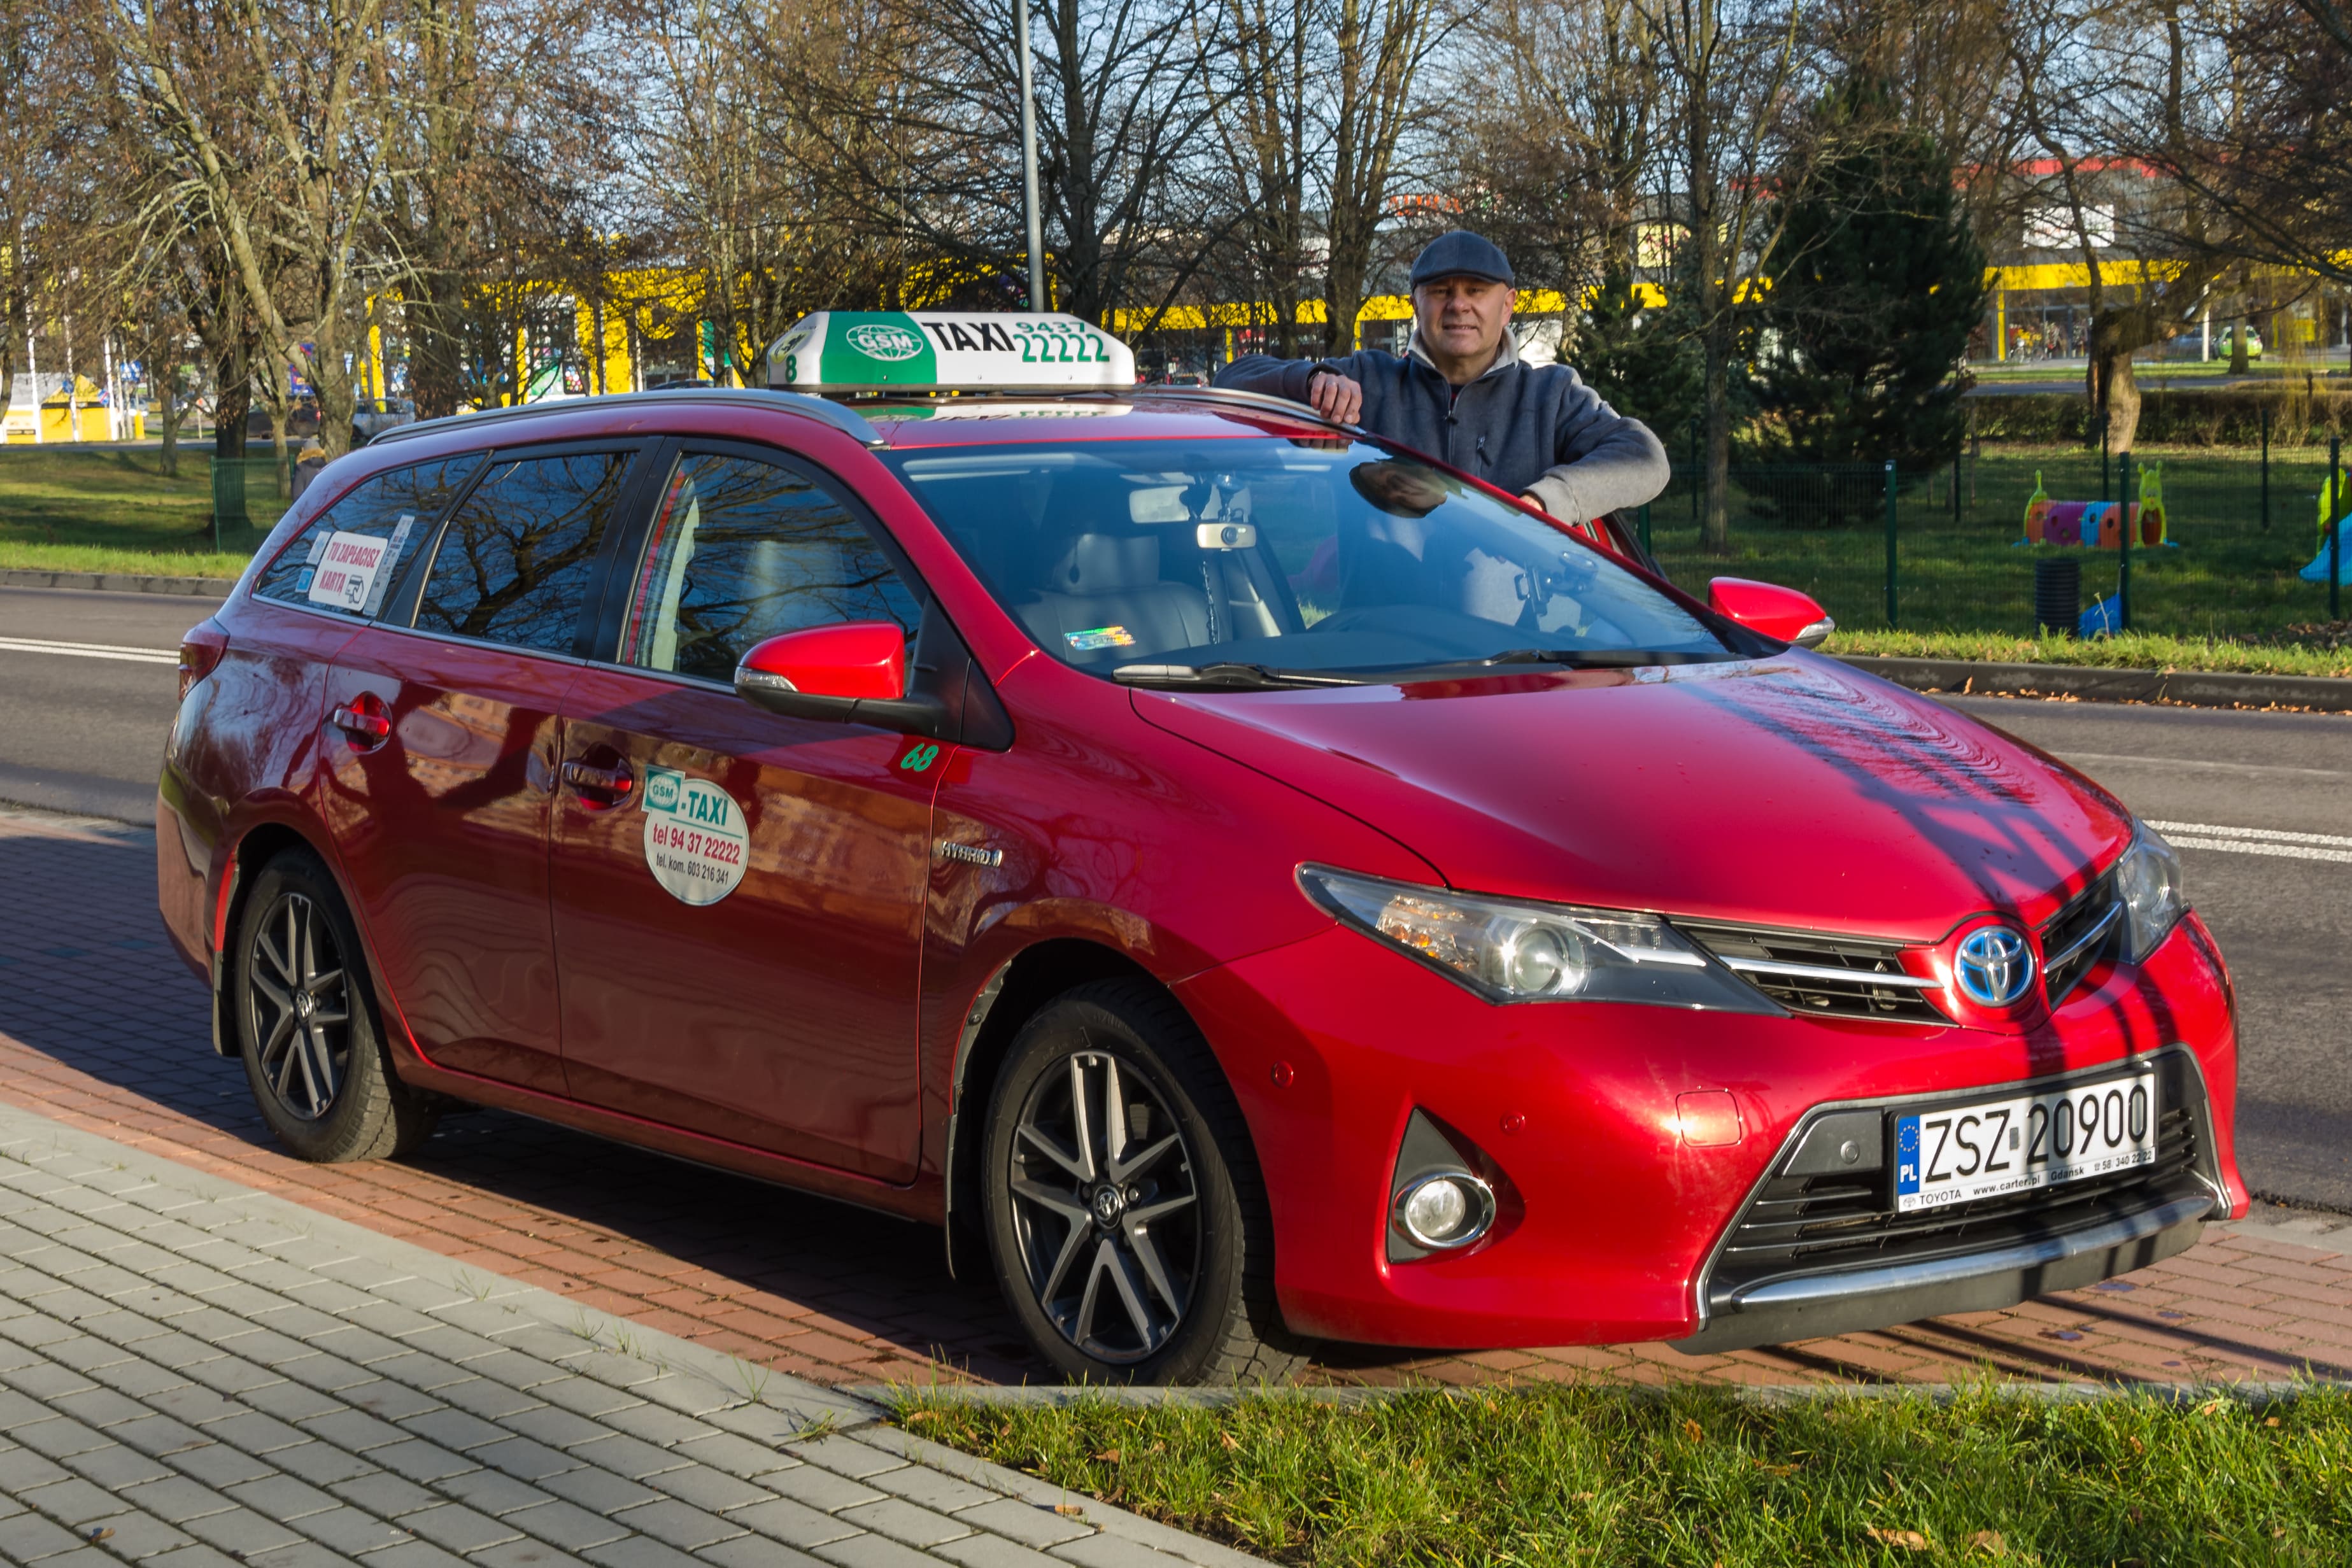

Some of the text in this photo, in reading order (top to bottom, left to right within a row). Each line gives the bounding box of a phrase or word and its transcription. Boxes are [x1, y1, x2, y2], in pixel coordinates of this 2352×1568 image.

[921, 322, 1016, 351] TAXI
[1016, 322, 1085, 333] 9437
[858, 334, 914, 350] GSM
[1013, 334, 1110, 362] 22222
[327, 542, 381, 568] TU ZAPŁACISZ
[319, 570, 347, 596] KARTĄ
[900, 743, 939, 772] 68
[653, 784, 674, 798] GSM
[653, 823, 740, 866] tel 94 37 22222
[656, 852, 729, 886] tel. kom. 603 216 341
[1925, 1084, 2148, 1184] ZSZ 20900
[1900, 1163, 1918, 1183] PL
[1920, 1189, 1962, 1205] TOYOTA
[1973, 1175, 2041, 1196] www.carter.pl
[2051, 1166, 2085, 1182] Gdańsk
[2116, 1155, 2130, 1167] 340
[2132, 1153, 2142, 1163] 22
[2143, 1150, 2152, 1161] 22
